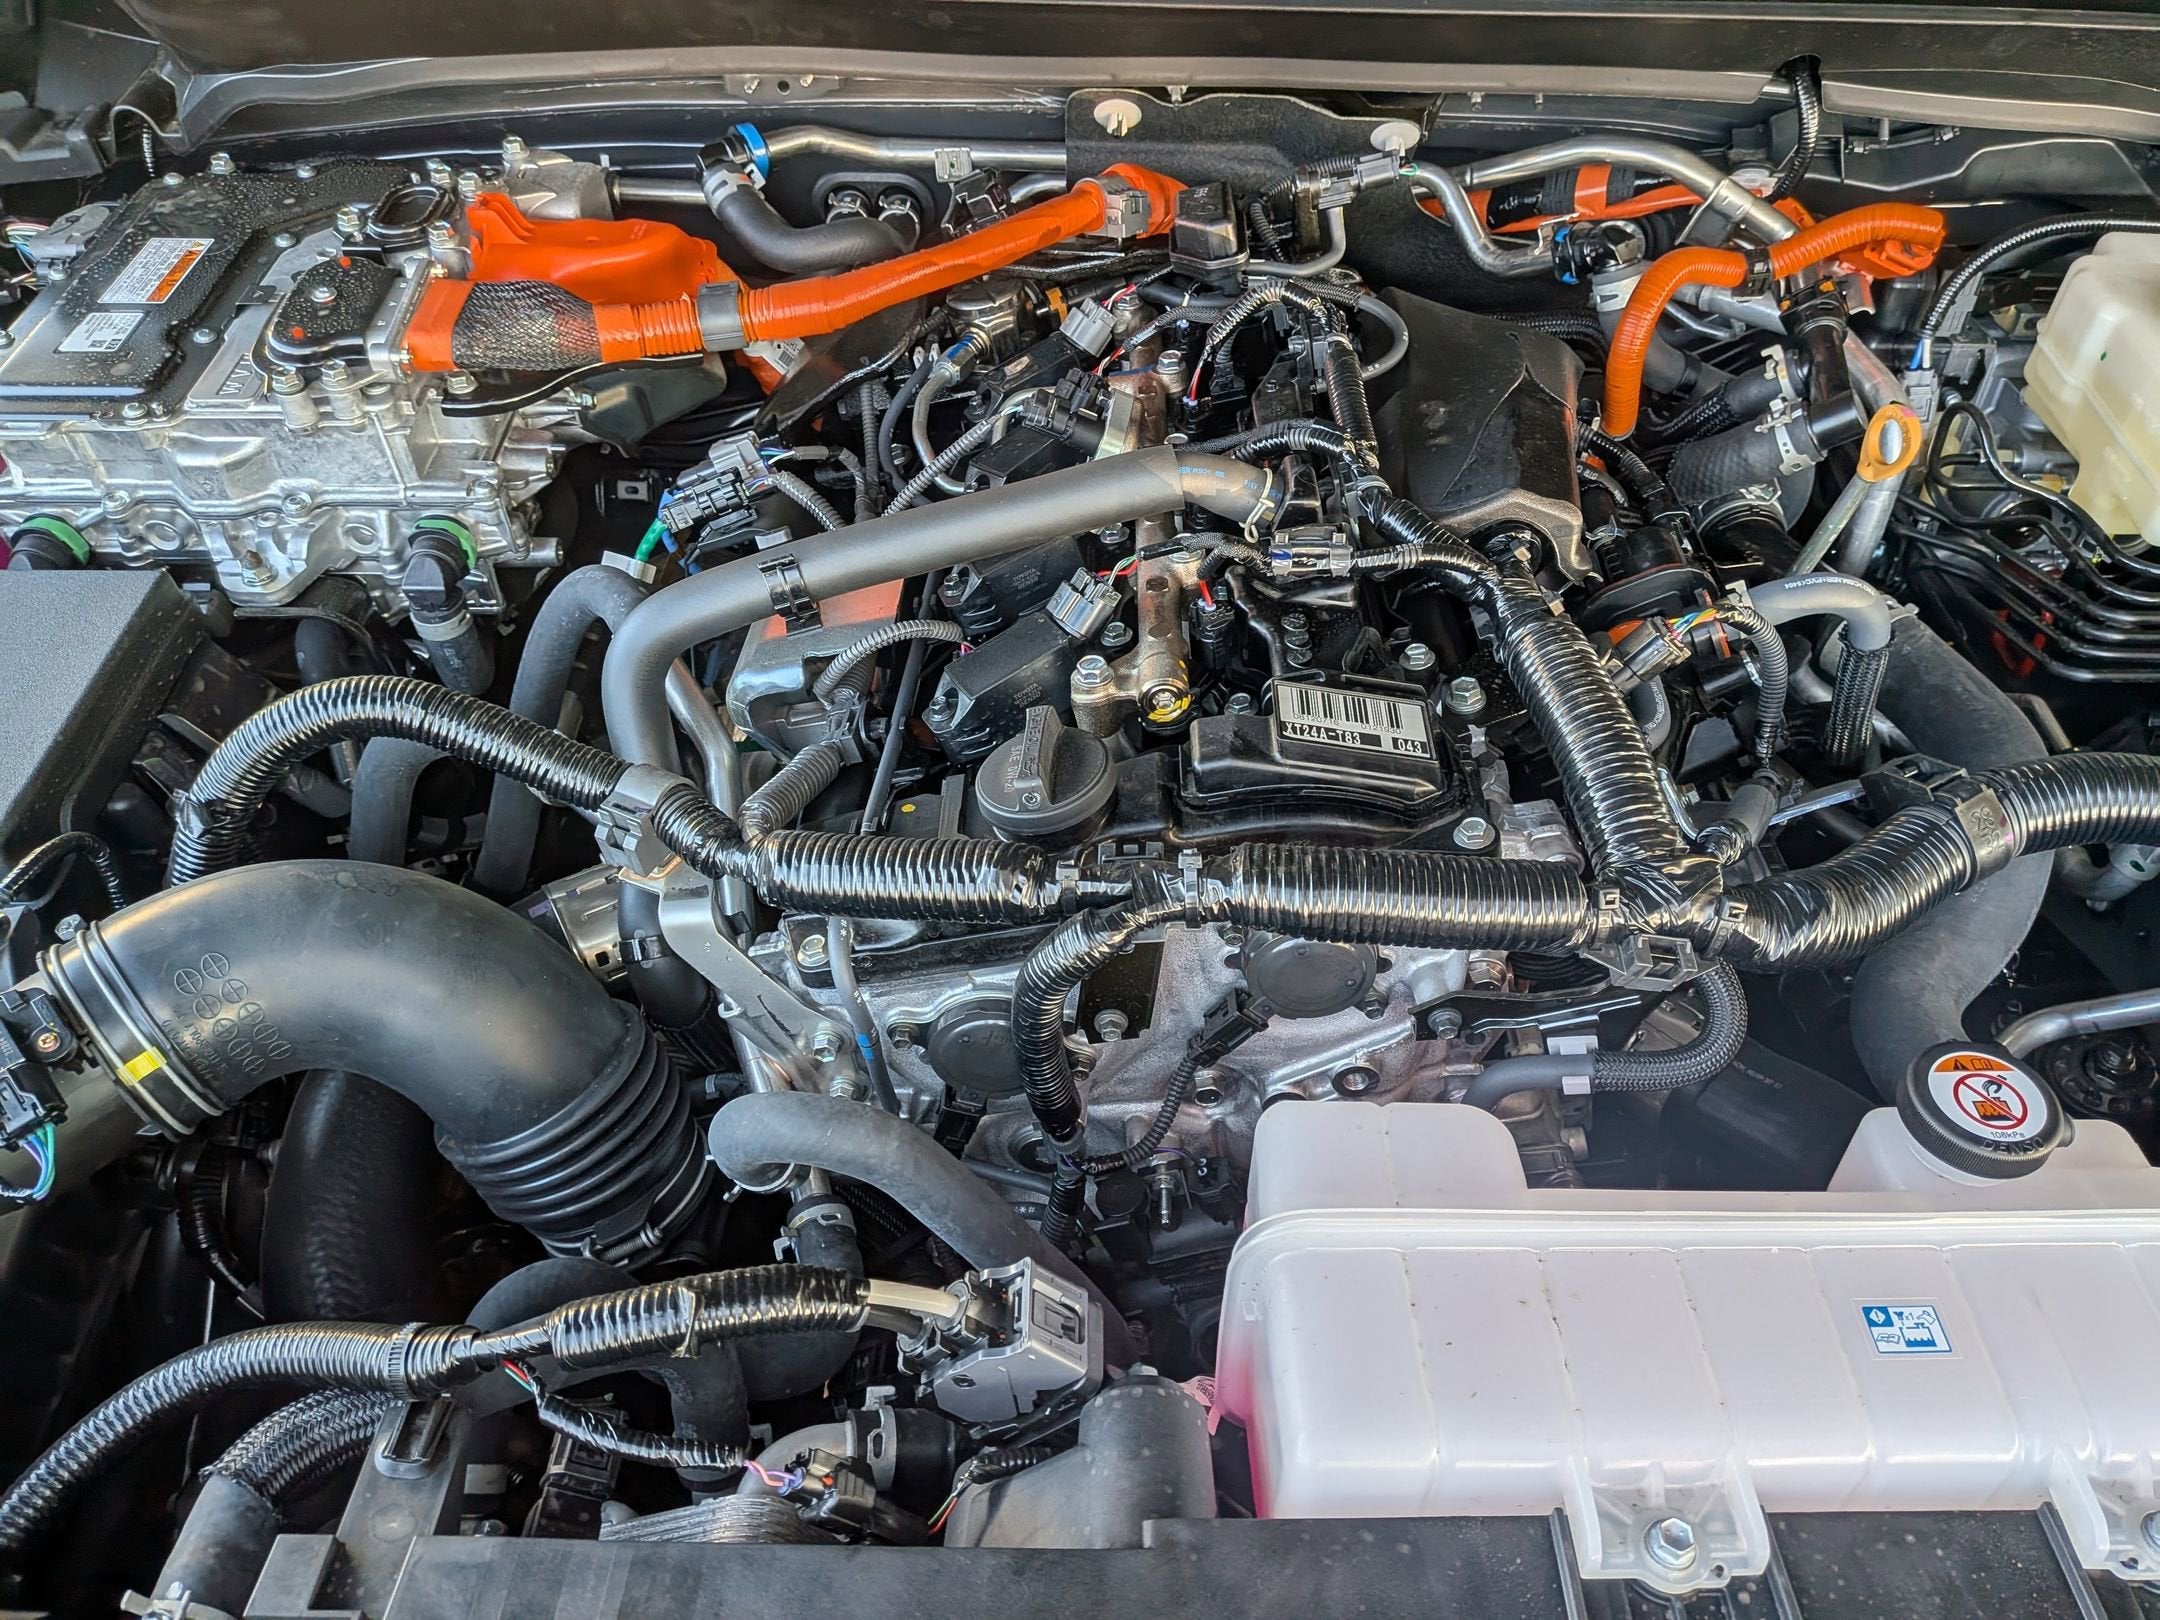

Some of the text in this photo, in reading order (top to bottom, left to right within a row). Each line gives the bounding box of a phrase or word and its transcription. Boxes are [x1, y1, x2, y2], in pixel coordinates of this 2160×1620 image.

[1013, 683, 1039, 699] TOYOTA
[1286, 722, 1422, 753] XT24A-T83 043
[1009, 745, 1022, 762] SAE
[1990, 1131, 2026, 1139] 108kPa
[1981, 1137, 2046, 1155] DENSO
